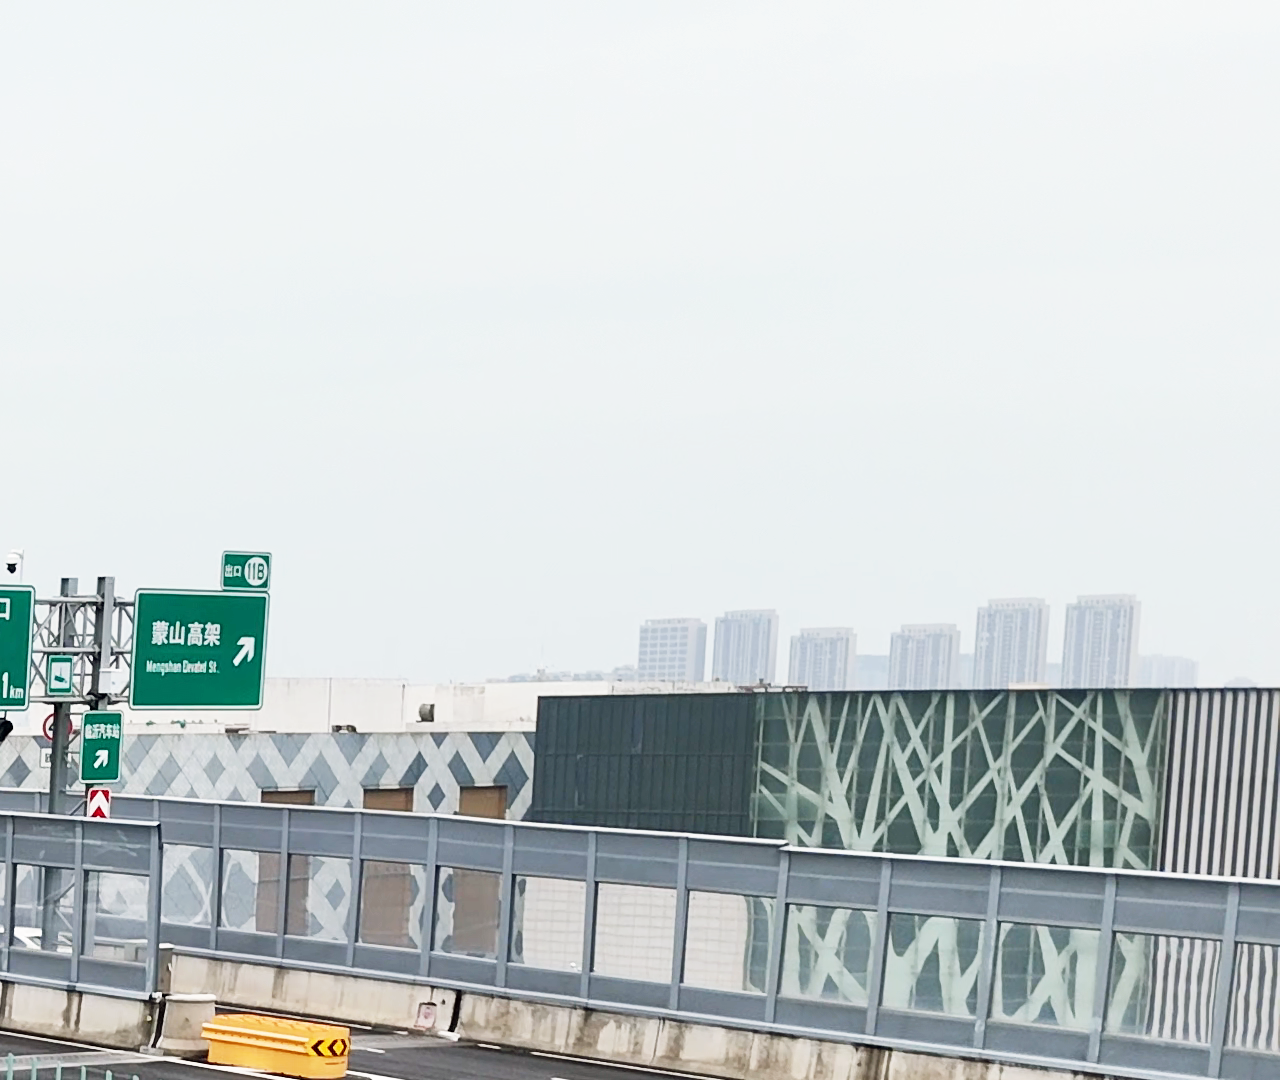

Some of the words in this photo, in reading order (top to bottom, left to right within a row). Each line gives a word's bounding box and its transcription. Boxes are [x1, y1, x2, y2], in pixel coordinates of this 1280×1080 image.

[225, 564, 242, 577] 出口
[248, 563, 265, 580] 11B
[151, 620, 221, 646] 蒙山高架
[146, 659, 182, 677] Mengshan
[208, 660, 220, 674] St.
